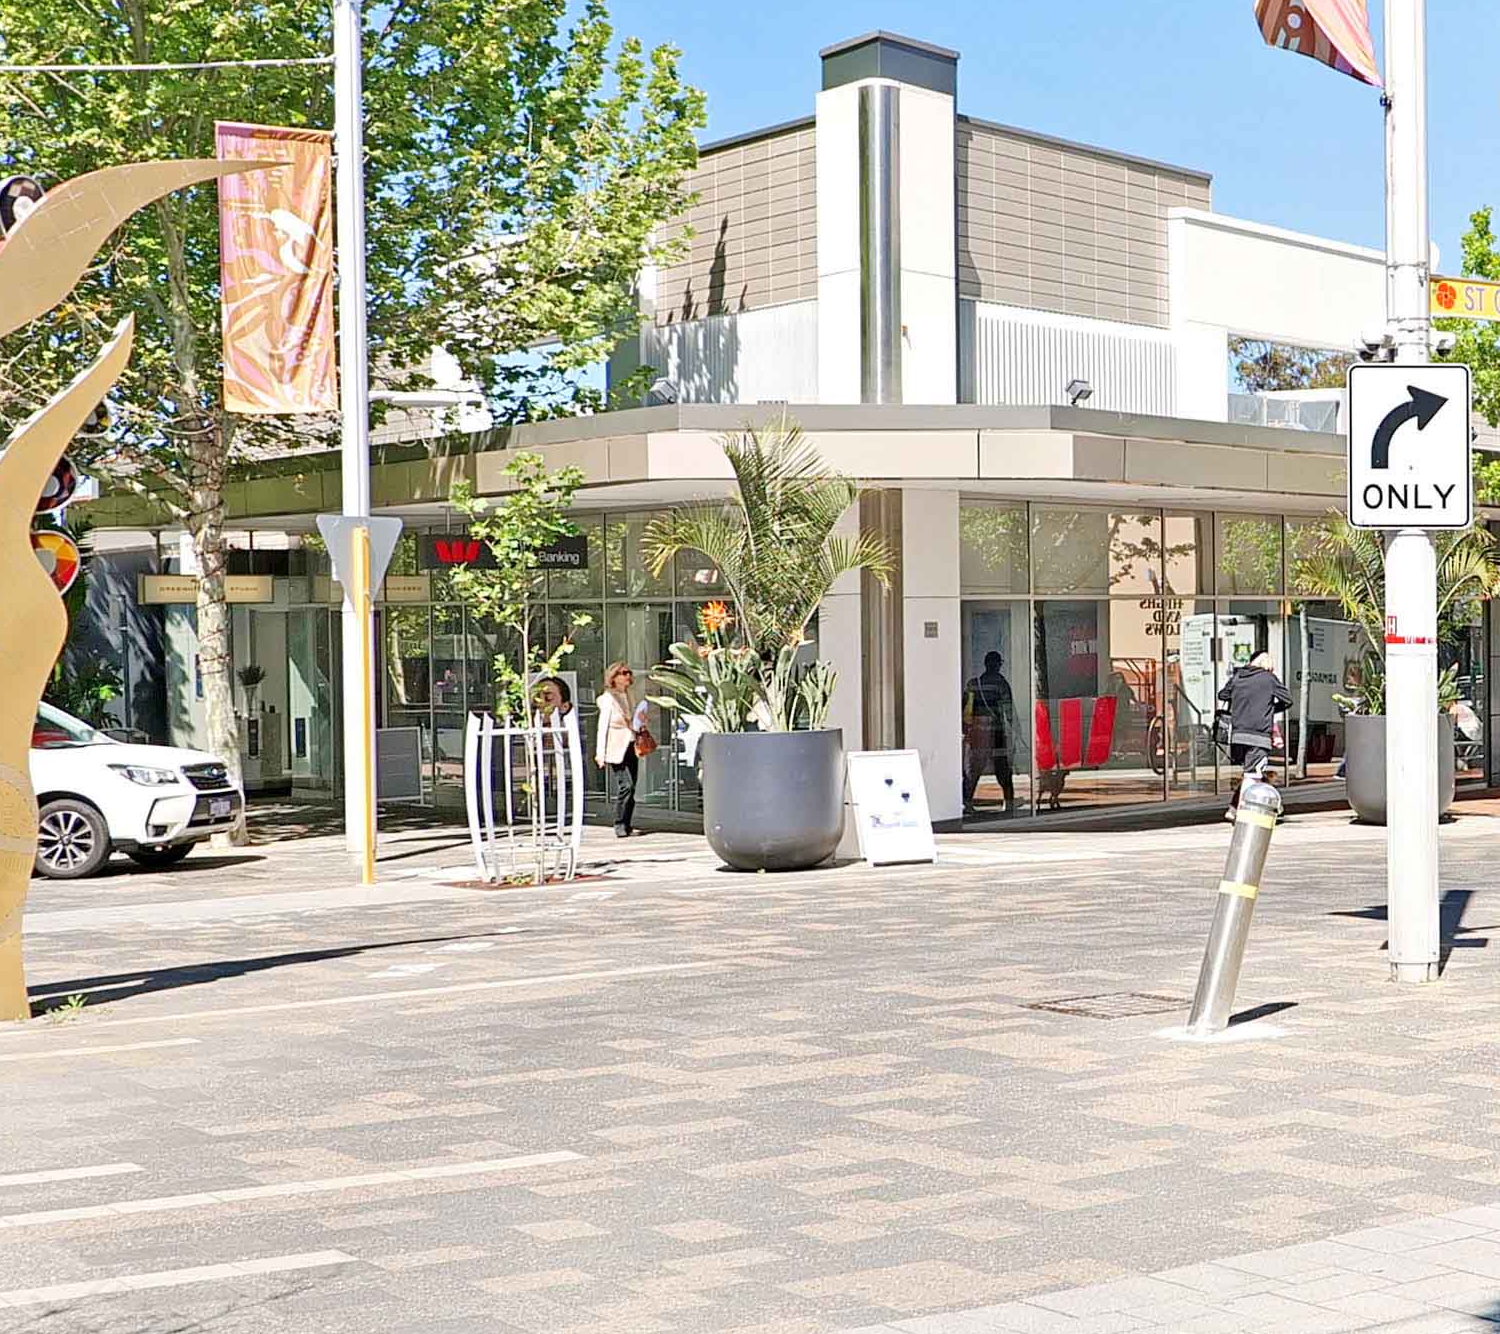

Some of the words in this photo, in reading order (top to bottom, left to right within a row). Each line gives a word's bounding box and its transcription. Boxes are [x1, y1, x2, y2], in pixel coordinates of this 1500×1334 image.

[1464, 285, 1486, 312] ST
[1362, 483, 1456, 510] ONLY
[538, 550, 580, 565] Banking
